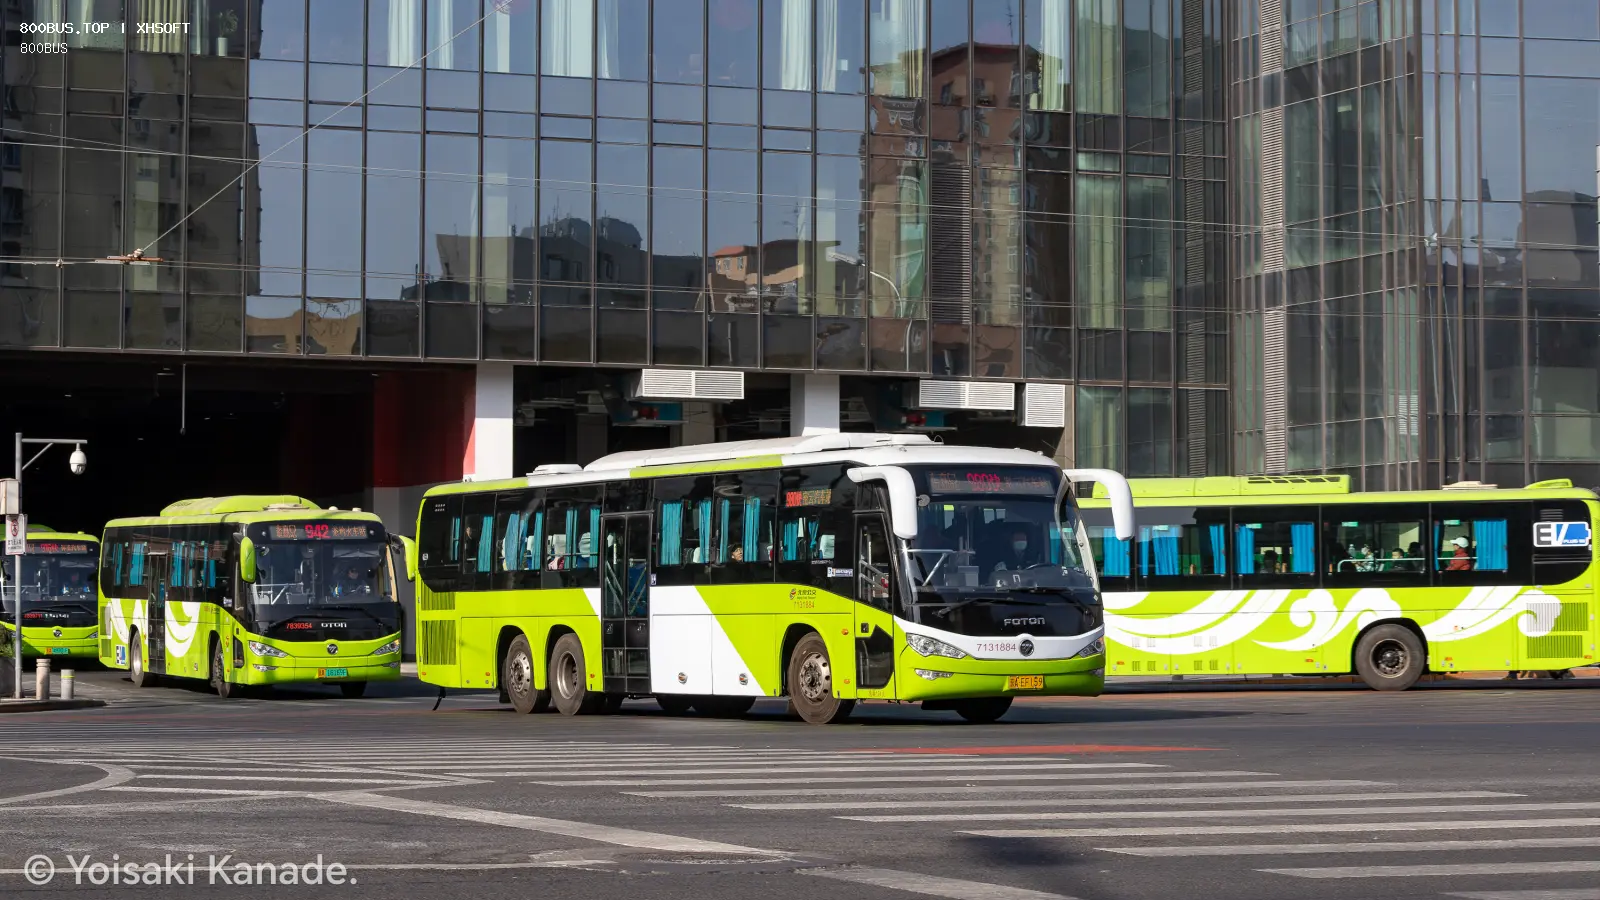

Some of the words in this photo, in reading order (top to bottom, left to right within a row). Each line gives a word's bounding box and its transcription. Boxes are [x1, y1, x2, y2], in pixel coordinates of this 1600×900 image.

[304, 524, 331, 539] 942
[1003, 617, 1046, 626] FOTON
[976, 642, 1017, 652] 7131884
